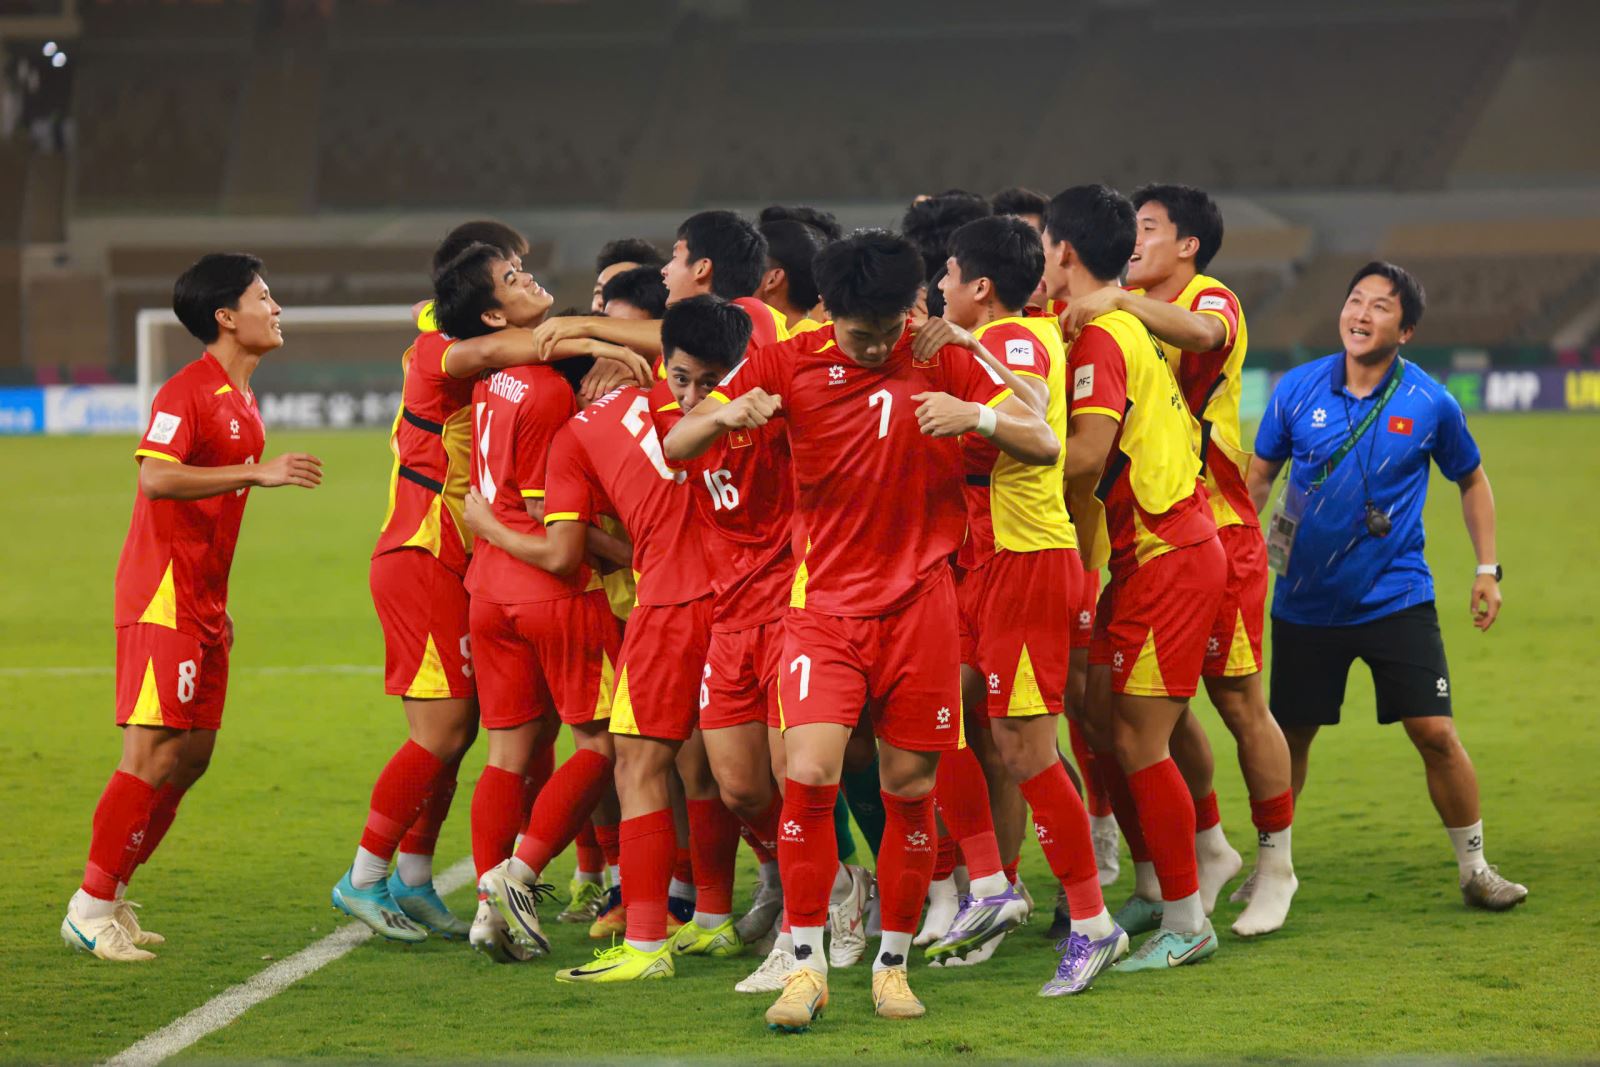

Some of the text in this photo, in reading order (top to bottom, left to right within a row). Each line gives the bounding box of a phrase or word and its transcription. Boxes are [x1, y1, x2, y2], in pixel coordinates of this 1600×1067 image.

[489, 371, 529, 404] KHANG
[1077, 377, 1091, 388] AFC
[1486, 372, 1540, 410] APP
[868, 389, 893, 439] 7
[703, 468, 739, 511] 16
[177, 659, 197, 703] 8
[790, 654, 811, 702] 7
